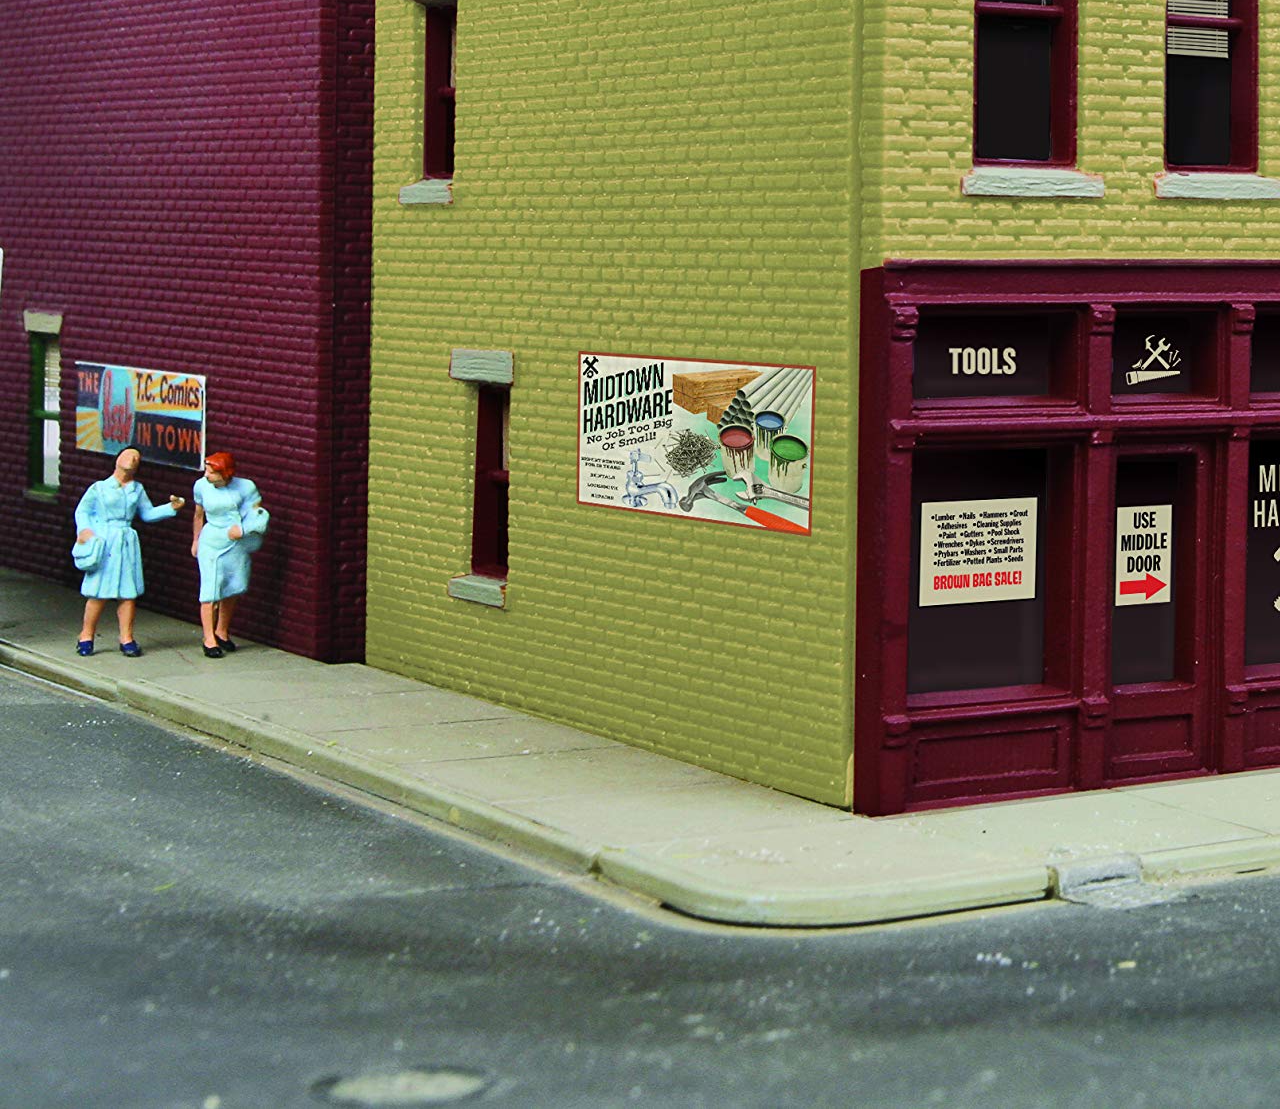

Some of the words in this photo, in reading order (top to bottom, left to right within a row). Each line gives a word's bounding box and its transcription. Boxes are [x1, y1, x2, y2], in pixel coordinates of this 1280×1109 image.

[949, 346, 1017, 375] TOOLS
[78, 371, 99, 394] THE
[160, 375, 200, 408] Comics
[584, 362, 664, 406] MIDTOWN
[583, 389, 673, 434] HARDWARE
[137, 422, 152, 447] IN
[155, 424, 202, 454] TOWN
[587, 435, 602, 444] No
[605, 428, 625, 440] Job
[628, 424, 650, 434] Too
[653, 418, 673, 429] Big
[602, 441, 616, 451] Or
[619, 431, 657, 447] Small!
[962, 512, 976, 520] Nails
[1000, 519, 1022, 528] Supplies
[1133, 511, 1156, 529] USE
[1120, 532, 1168, 552] MIDDLE
[1008, 554, 1024, 562] Seeds
[1127, 554, 1161, 573] DOOR
[933, 574, 970, 590] BROWN
[972, 572, 992, 588] BAG
[994, 570, 1022, 586] SALE!
